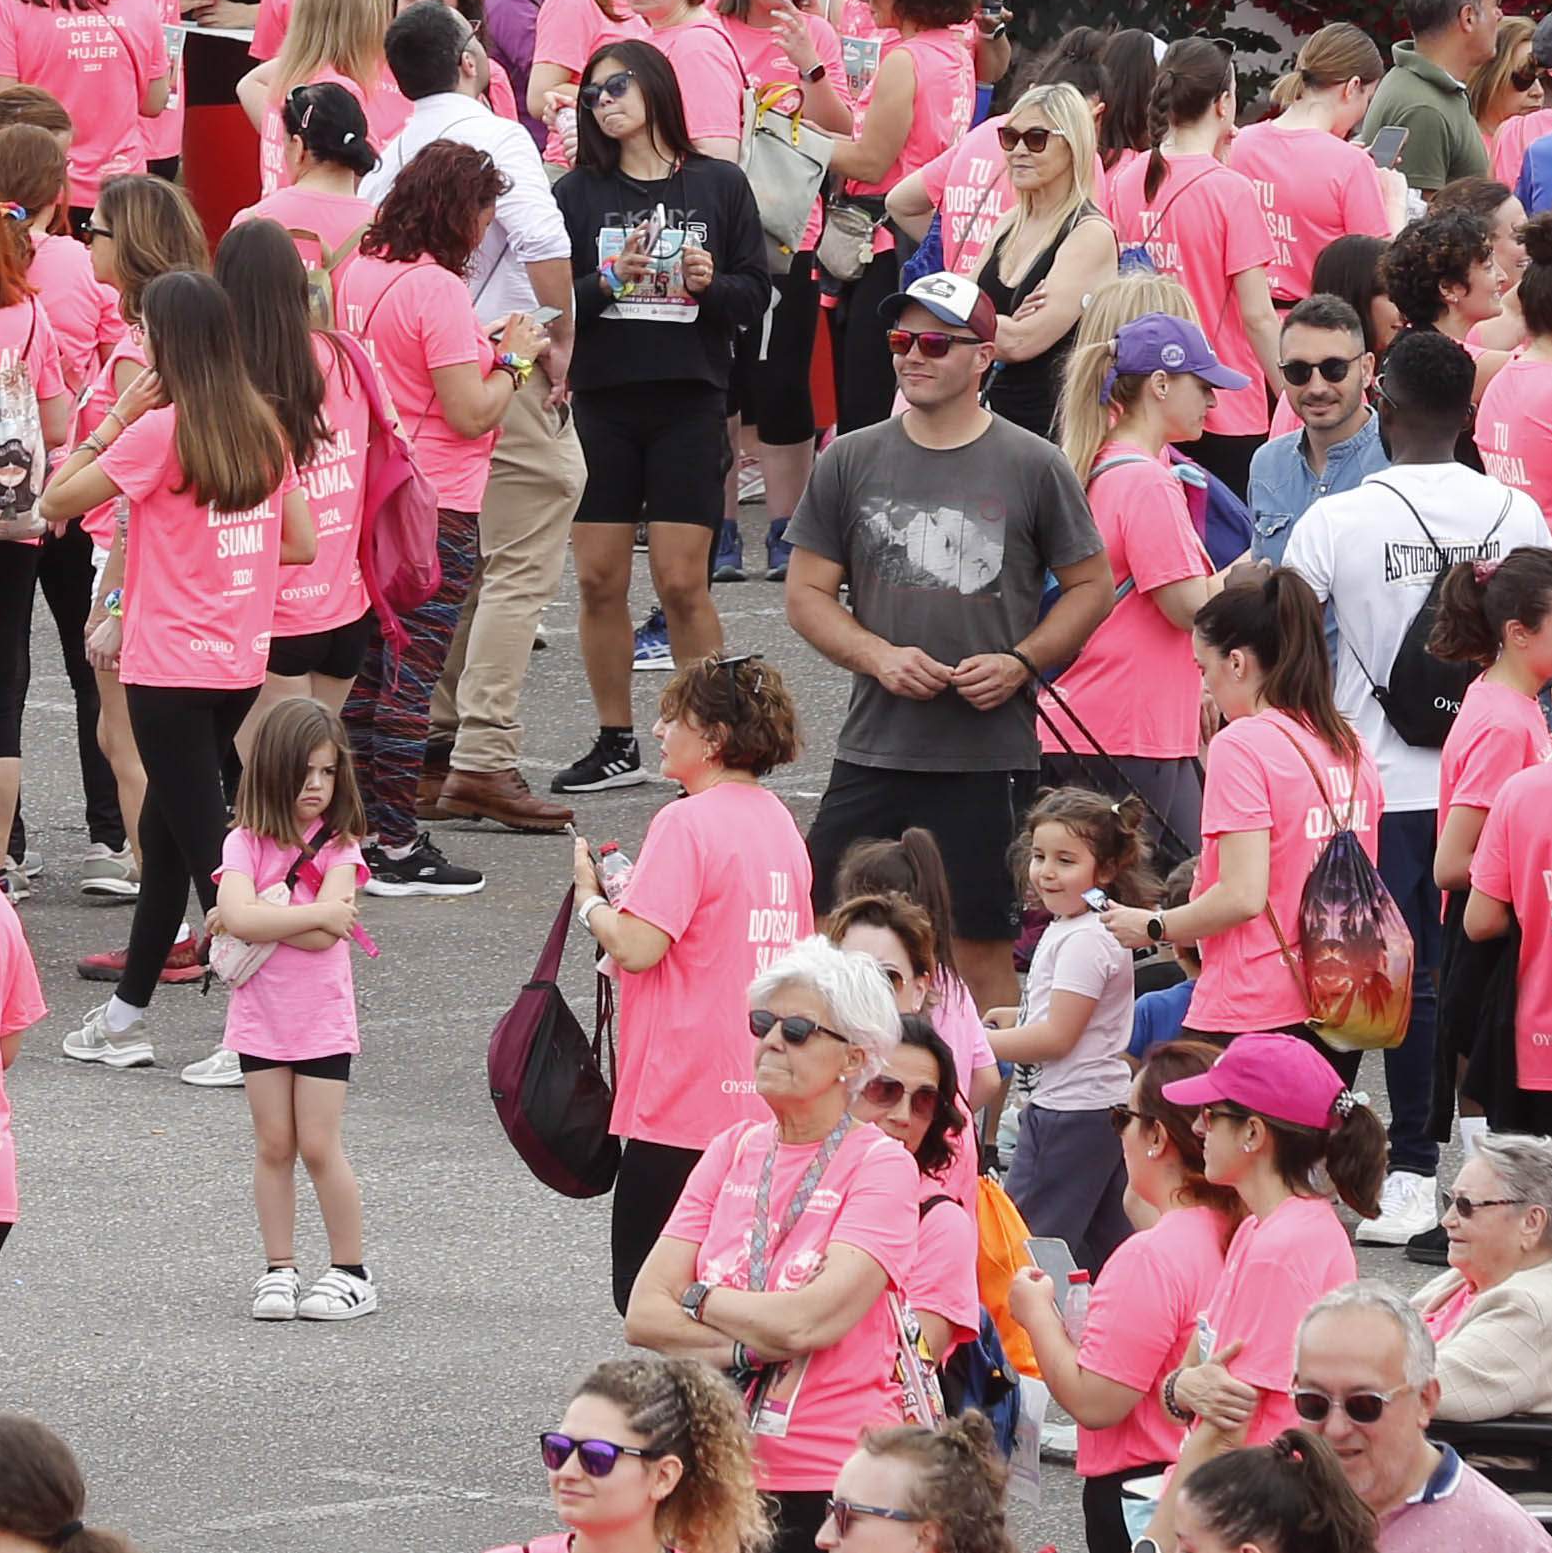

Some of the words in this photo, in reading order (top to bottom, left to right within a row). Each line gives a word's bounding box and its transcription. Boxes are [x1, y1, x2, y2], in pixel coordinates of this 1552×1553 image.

[56, 15, 125, 29] CARRERA
[71, 32, 92, 43] DE
[96, 31, 114, 43] LA
[67, 47, 118, 59] MUJER
[969, 158, 993, 185] TU
[946, 187, 1003, 216] DORSAL
[1253, 179, 1275, 208] TU
[1139, 211, 1163, 238] TU
[1263, 212, 1298, 242] SAL
[299, 429, 357, 469] SAL
[1493, 422, 1509, 451] TU
[217, 525, 263, 559] SUMA
[281, 583, 330, 601] OYSHO
[190, 639, 234, 653] OYSHO
[1434, 697, 1461, 714] OYS
[1328, 767, 1352, 797] TU
[770, 872, 788, 905] TU
[748, 909, 798, 942] DORSAL
[721, 1080, 757, 1094] OYSH
